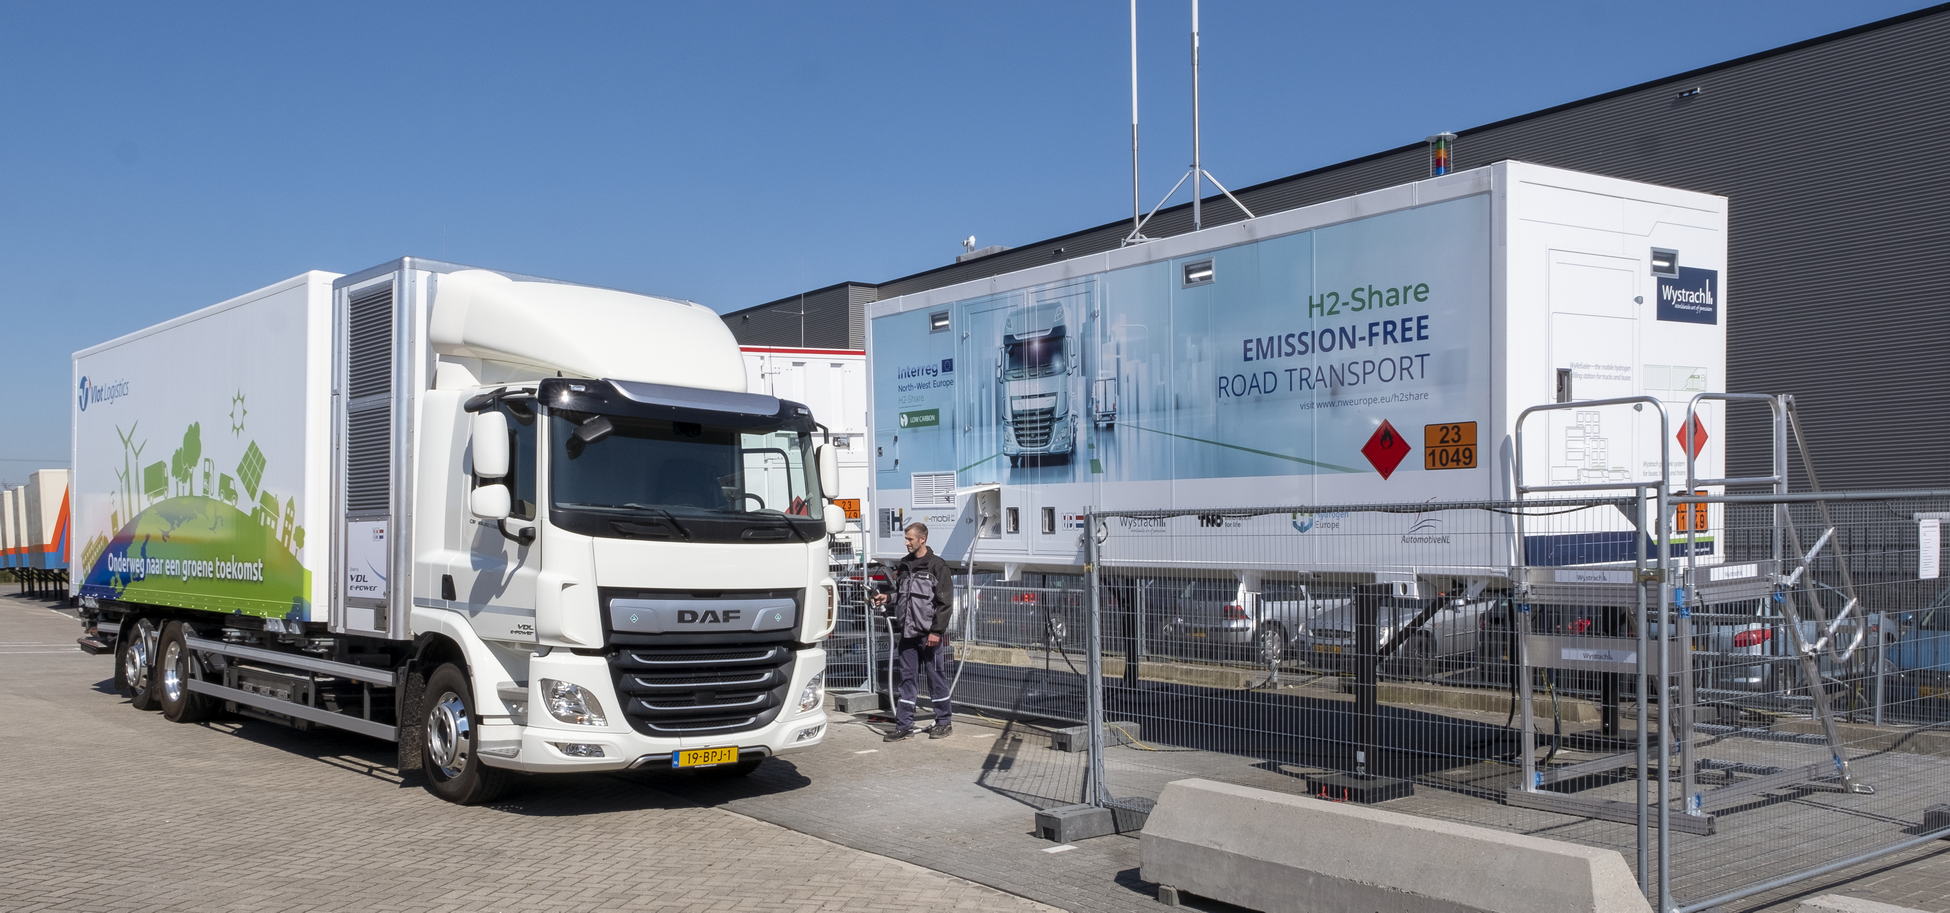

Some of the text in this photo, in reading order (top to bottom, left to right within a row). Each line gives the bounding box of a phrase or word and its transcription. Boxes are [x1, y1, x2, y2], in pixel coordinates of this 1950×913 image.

[1308, 282, 1430, 319] H2-Share
[1661, 283, 1706, 306] Wystrach
[1243, 314, 1429, 362] EMISSION-FREE
[897, 365, 939, 380] Interreg
[1218, 353, 1431, 399] ROAD TRANSPORT
[104, 379, 129, 405] Logistics
[897, 379, 954, 393] North-West Europe
[1299, 391, 1430, 410] visit www.nweurope.eu/h2share
[1439, 424, 1462, 444] 23
[1428, 447, 1473, 468] 1049
[841, 500, 852, 510] 23
[1315, 520, 1340, 531] Europe
[1400, 535, 1451, 544] AutomotiveNL
[107, 551, 264, 582] Onderweg naar een groene toekomst
[349, 574, 369, 583] VDL
[677, 609, 741, 624] DAF
[517, 623, 535, 631] VDL
[687, 749, 731, 765] 19-BPJ-1
